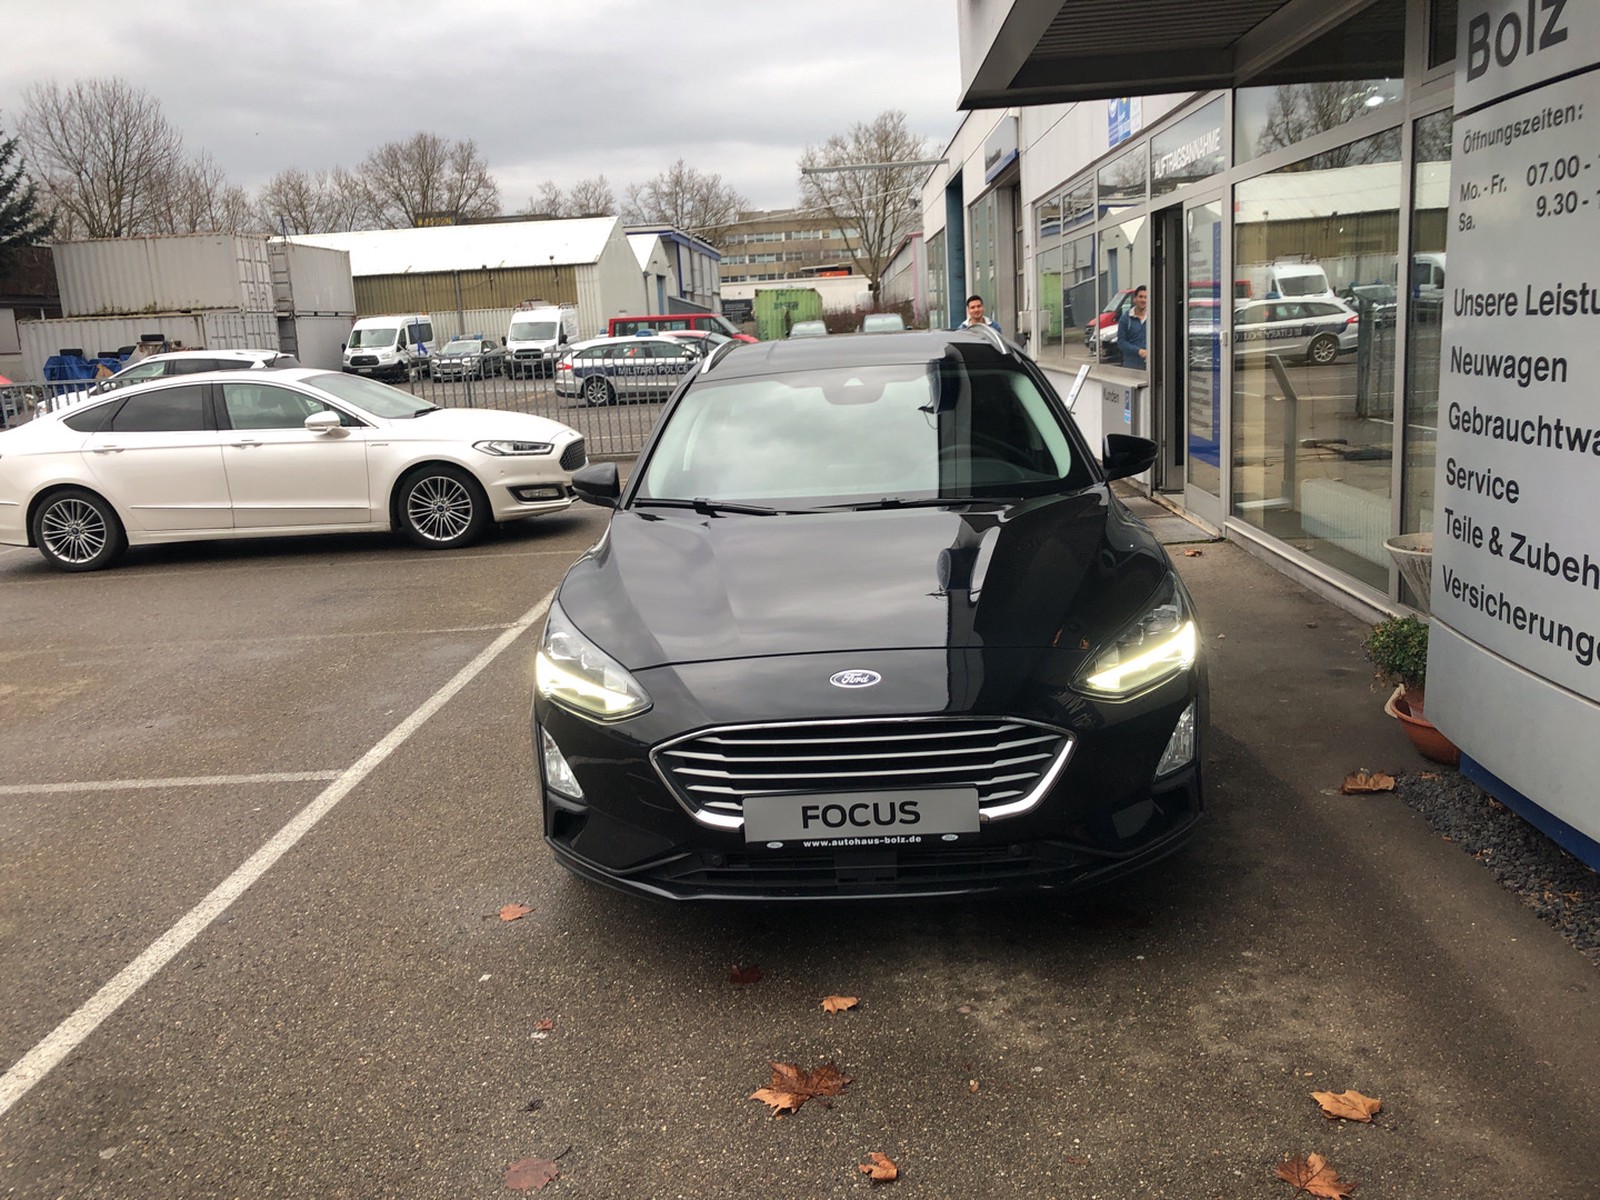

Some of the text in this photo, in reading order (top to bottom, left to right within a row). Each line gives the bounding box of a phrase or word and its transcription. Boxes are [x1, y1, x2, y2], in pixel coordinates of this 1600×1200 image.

[1467, 0, 1568, 83] Bolz
[1462, 104, 1584, 155] Öffnungszeiten:
[1459, 212, 1476, 232] Sa.
[1454, 287, 1518, 317] Unsere
[618, 365, 689, 375] MILITARY POLCE
[1450, 345, 1568, 388] Neuwagen
[1446, 457, 1520, 504] Service
[1444, 507, 1600, 590] Teile & Zubeh
[801, 800, 921, 829] FOCUS
[803, 834, 922, 848] www.autohaus-bolz.de
